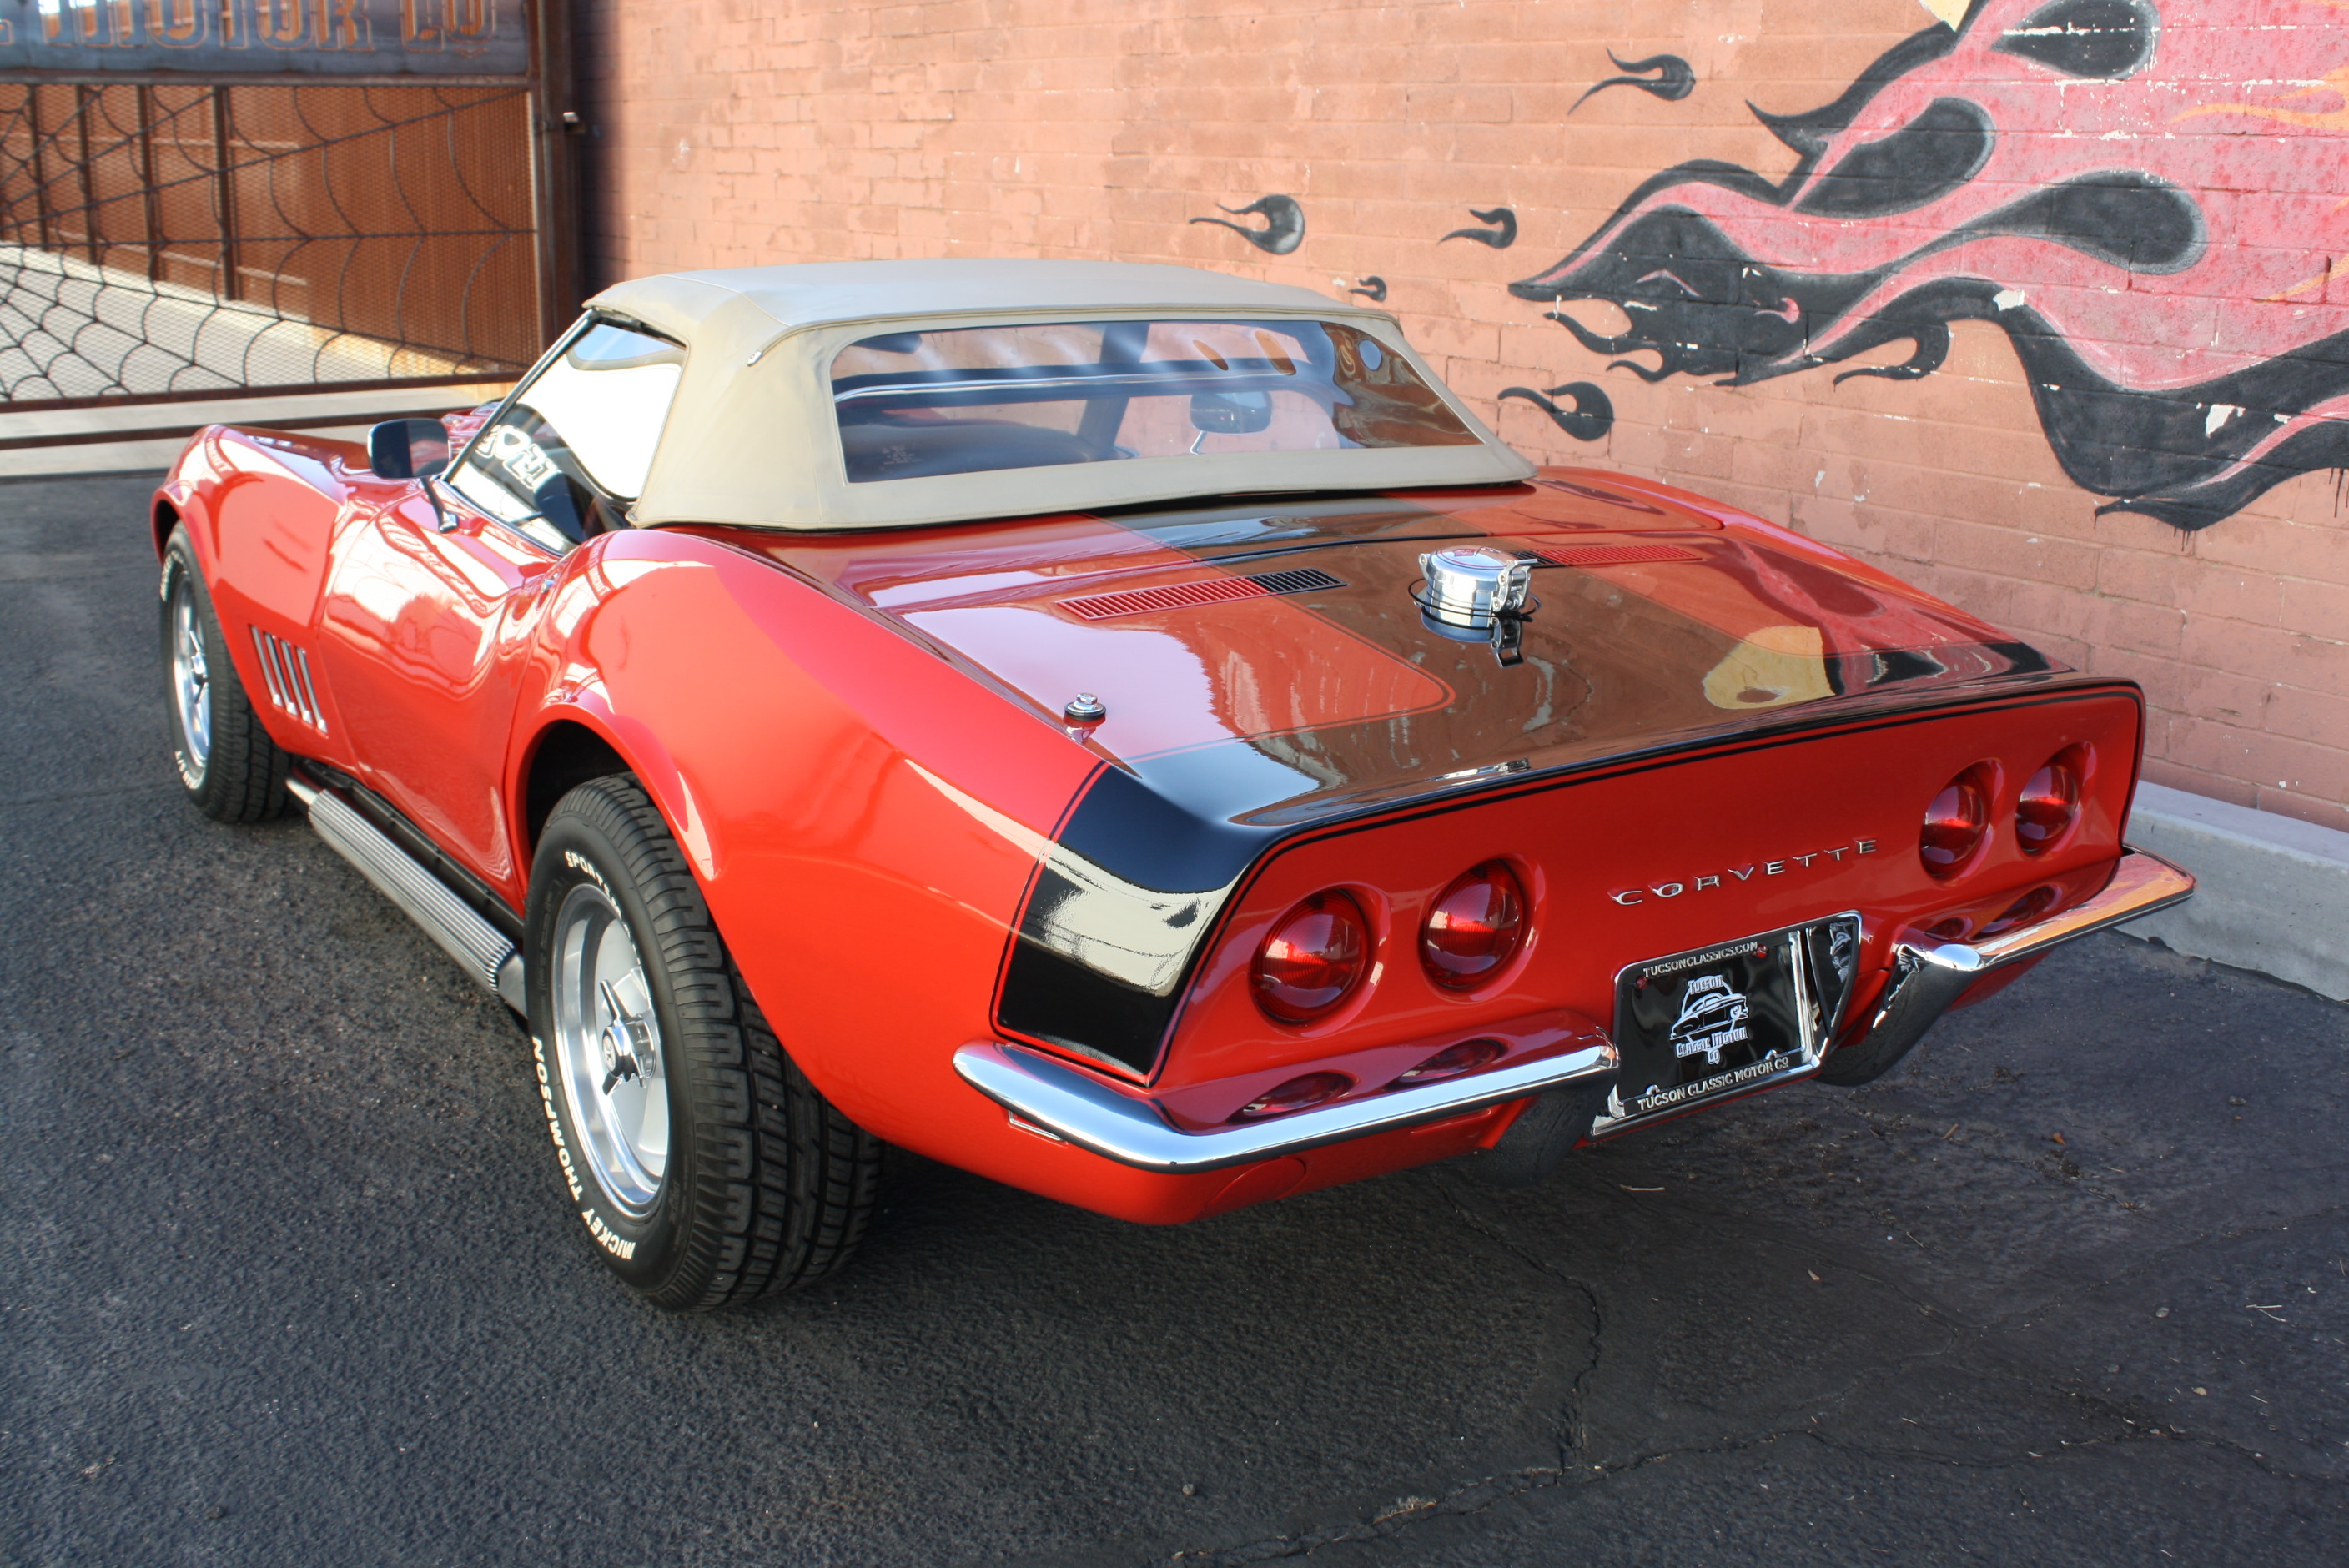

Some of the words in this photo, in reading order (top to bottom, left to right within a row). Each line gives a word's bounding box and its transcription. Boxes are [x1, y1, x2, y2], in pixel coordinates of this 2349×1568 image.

[1611, 838, 1878, 906] CORVETTE
[1643, 941, 1758, 978] TUCSONCLASSICS.COM
[1637, 1087, 1686, 1111] TUCSON
[1688, 1073, 1733, 1097] CLASSIC
[1734, 1061, 1773, 1083] MOTOR
[531, 1036, 584, 1201] THOMPSON
[582, 1209, 636, 1259] MICKEY
